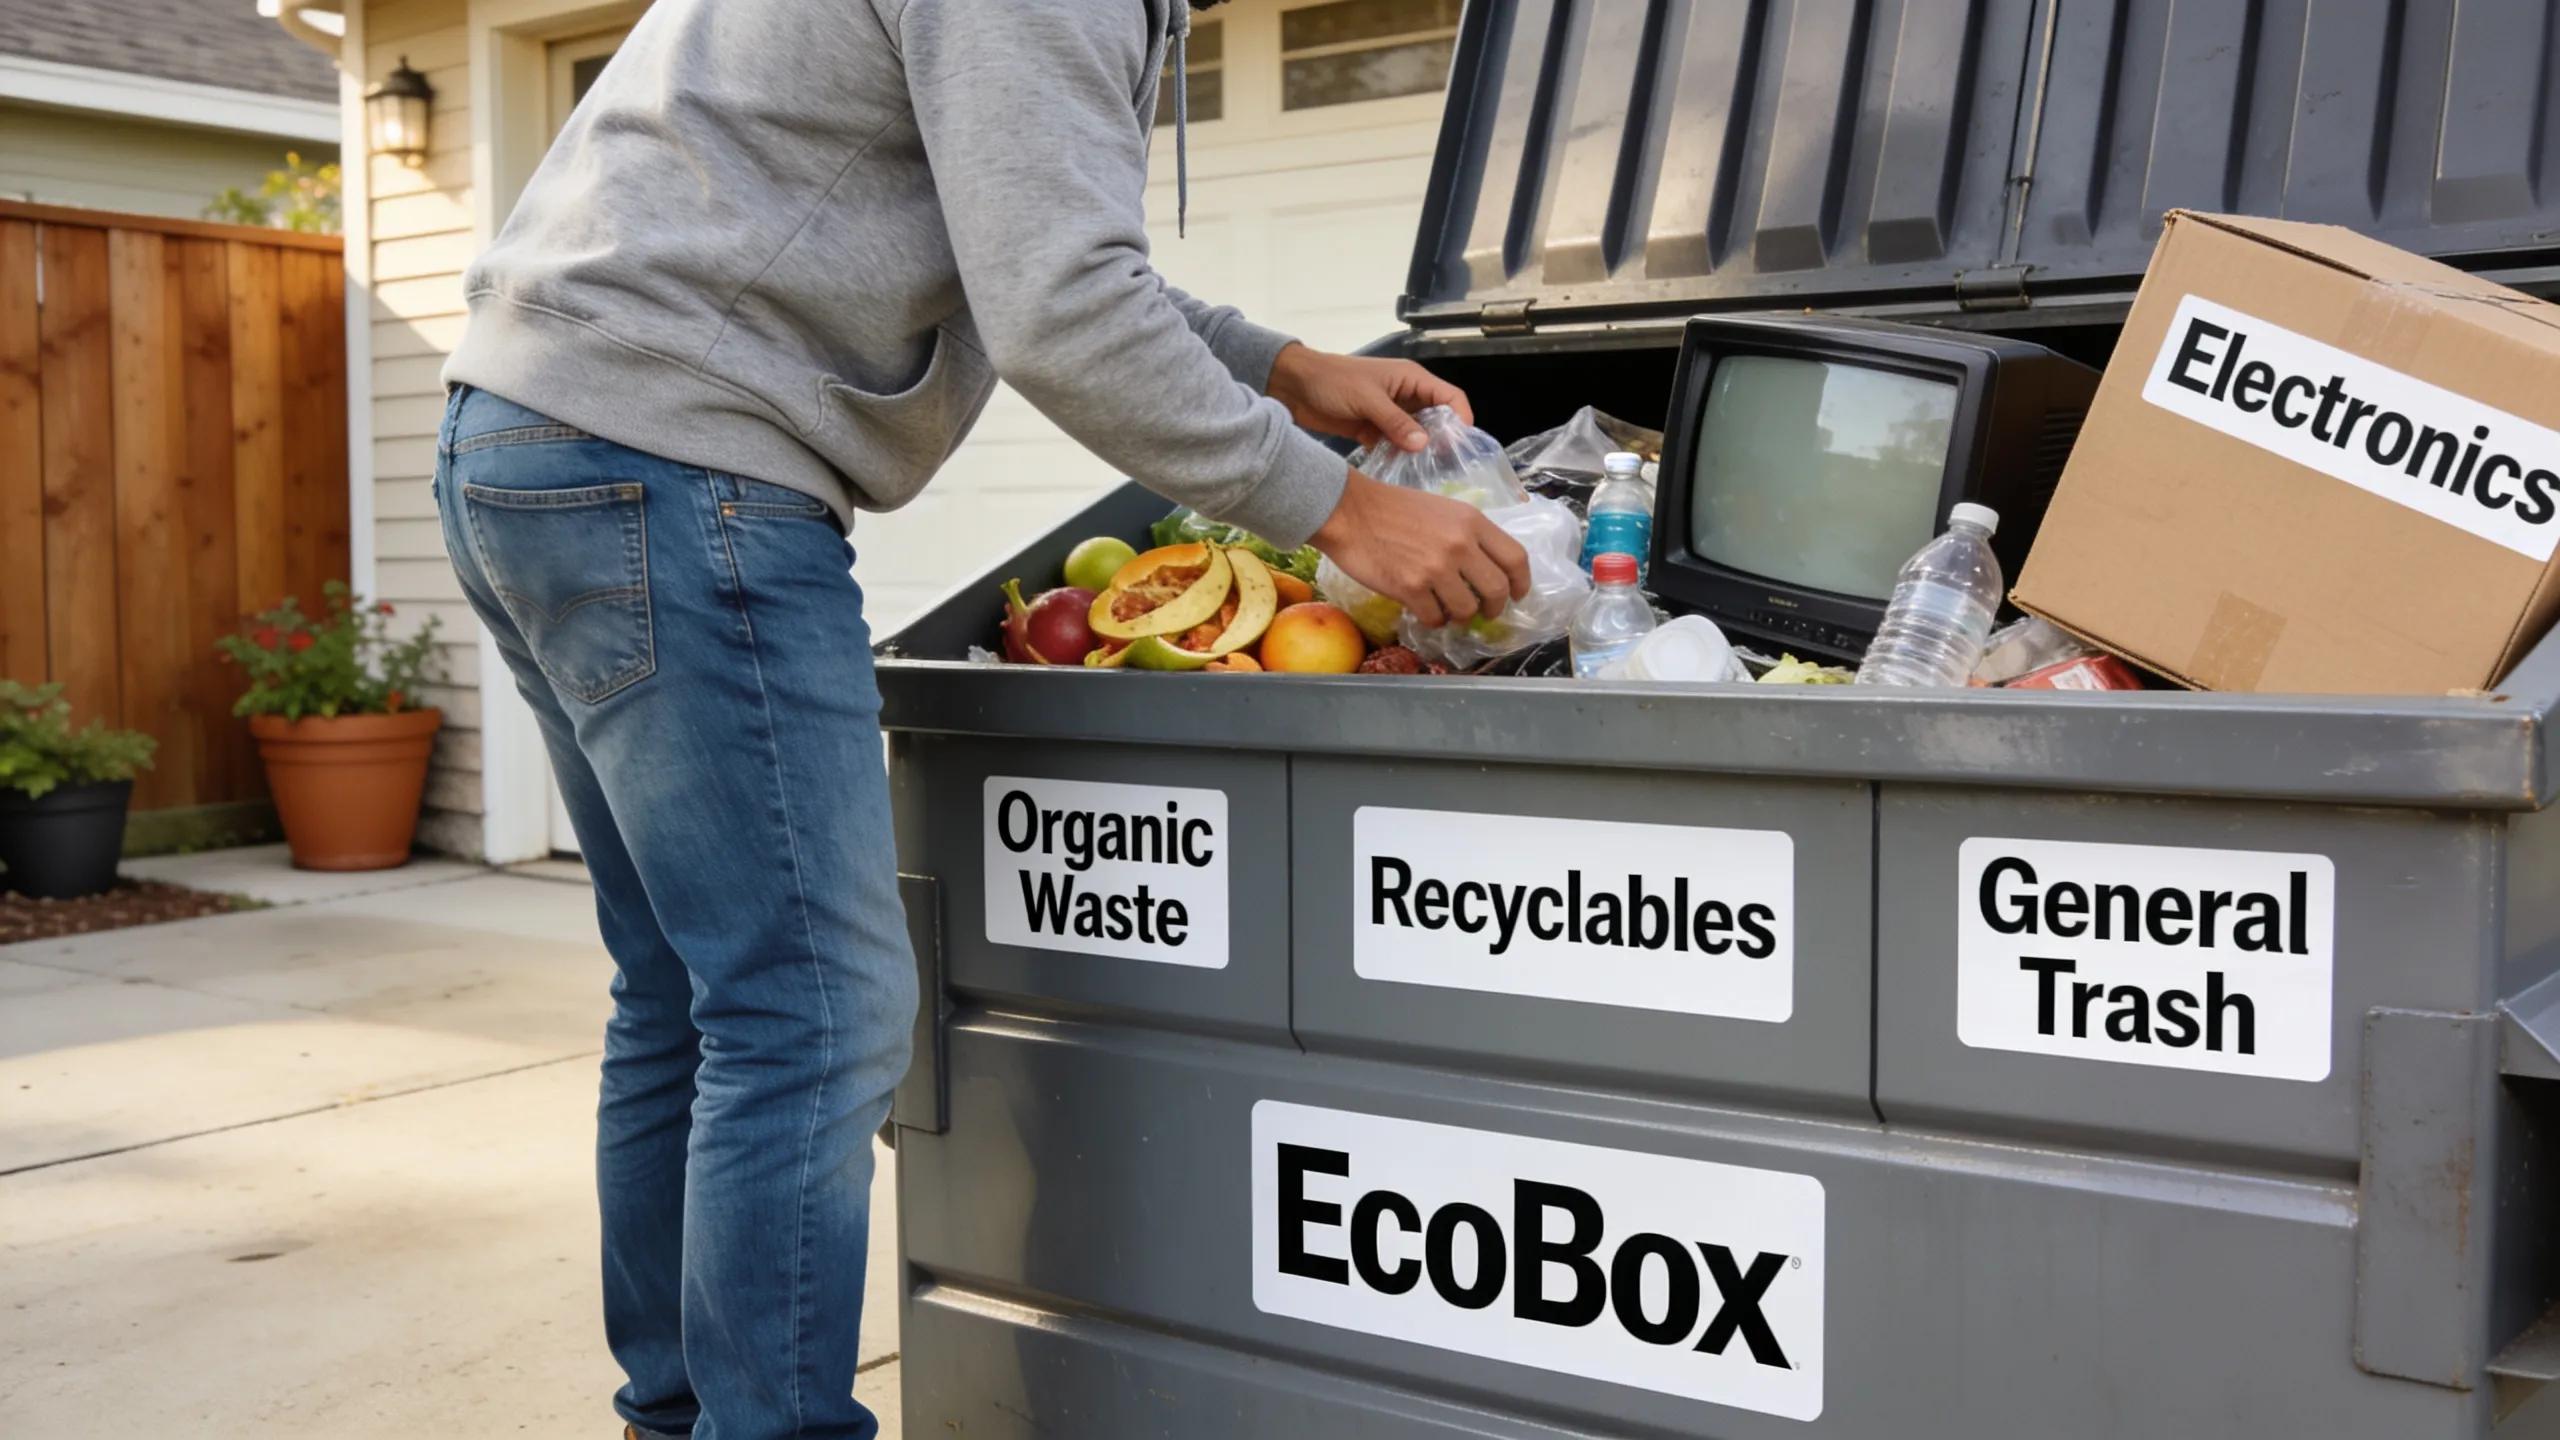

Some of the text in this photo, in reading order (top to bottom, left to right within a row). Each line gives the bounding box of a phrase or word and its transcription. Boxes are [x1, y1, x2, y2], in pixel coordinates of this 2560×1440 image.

[2167, 317, 2560, 525] Electronics
[997, 789, 1215, 872] Organic
[1018, 869, 1190, 947] Waste
[1371, 855, 1776, 959] Recyclables
[1979, 856, 2310, 955] General
[2019, 956, 2255, 1055] Trash
[1276, 1142, 1793, 1370] EcoBox
